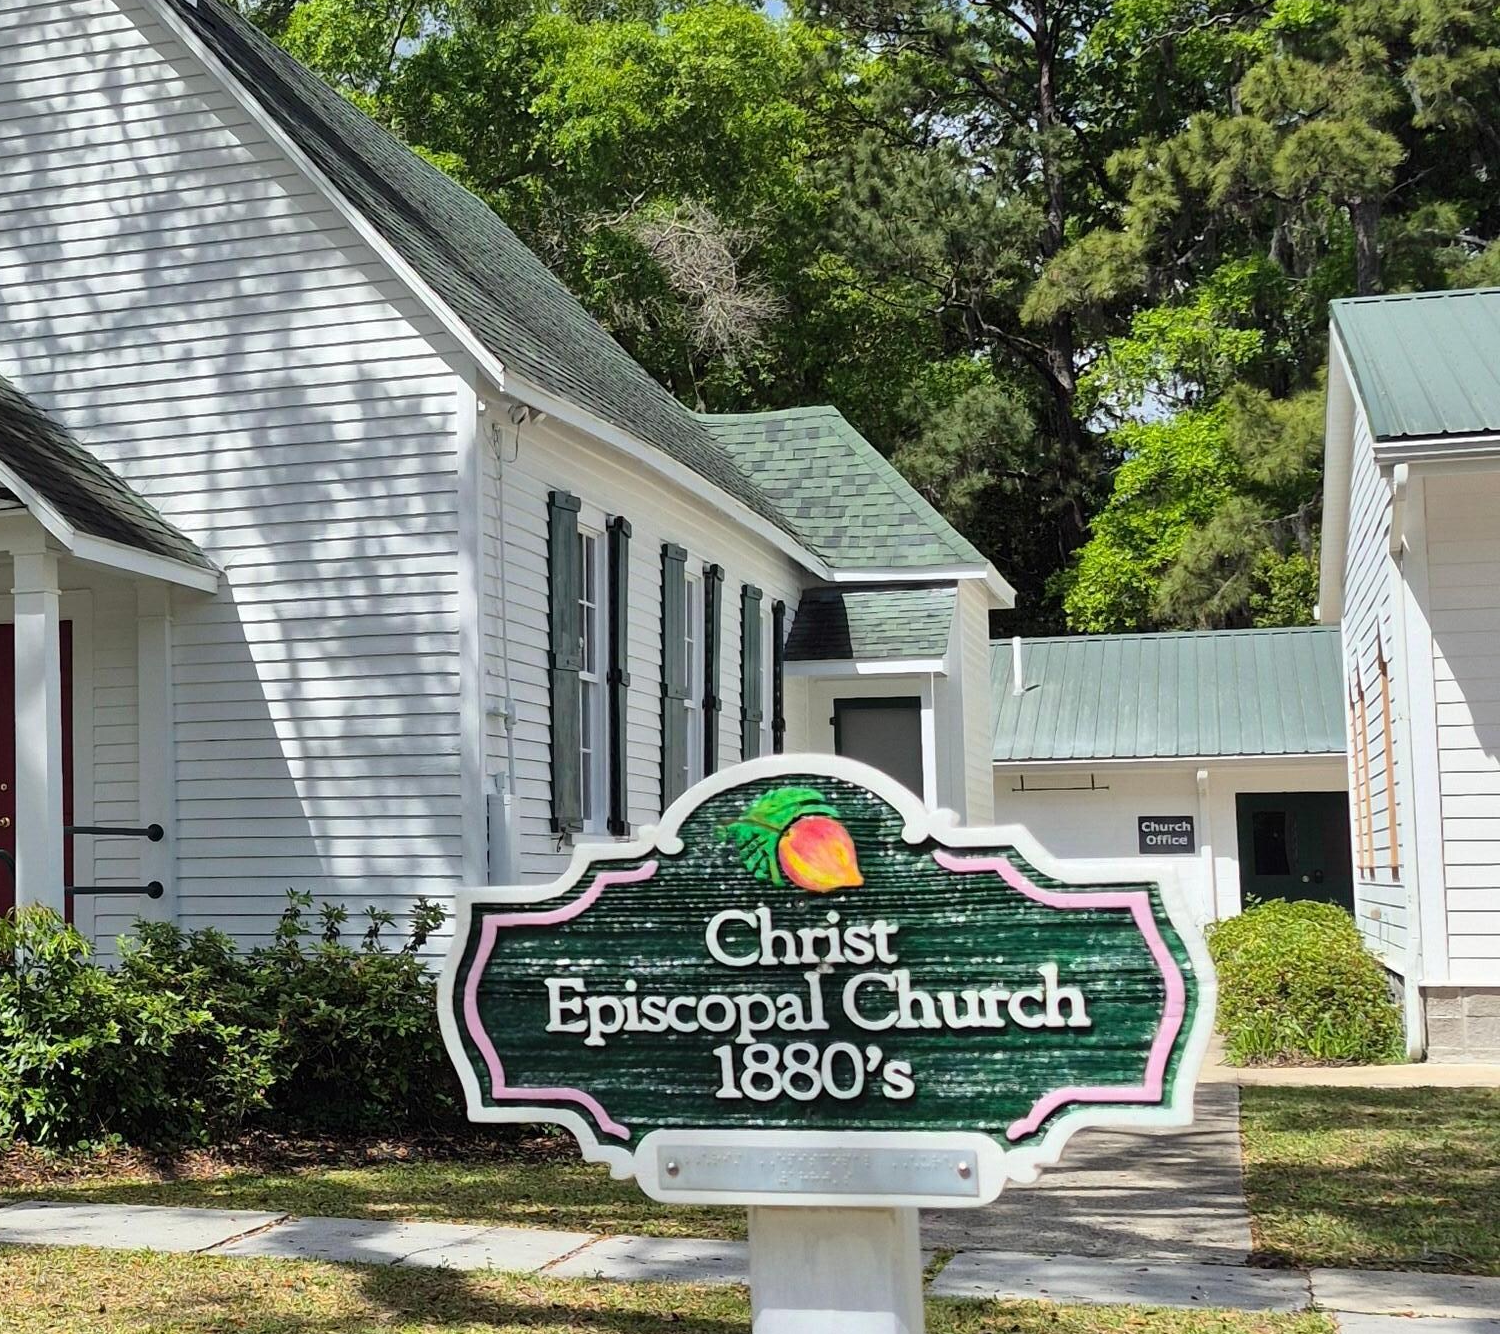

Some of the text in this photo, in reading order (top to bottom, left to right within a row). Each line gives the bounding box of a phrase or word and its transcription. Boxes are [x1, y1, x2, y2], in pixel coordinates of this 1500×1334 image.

[1141, 821, 1191, 832] Church
[1146, 835, 1188, 845] Office
[705, 907, 900, 966] Christ
[544, 962, 1092, 1046] Episcopal Church
[712, 1042, 915, 1101] 1880's
